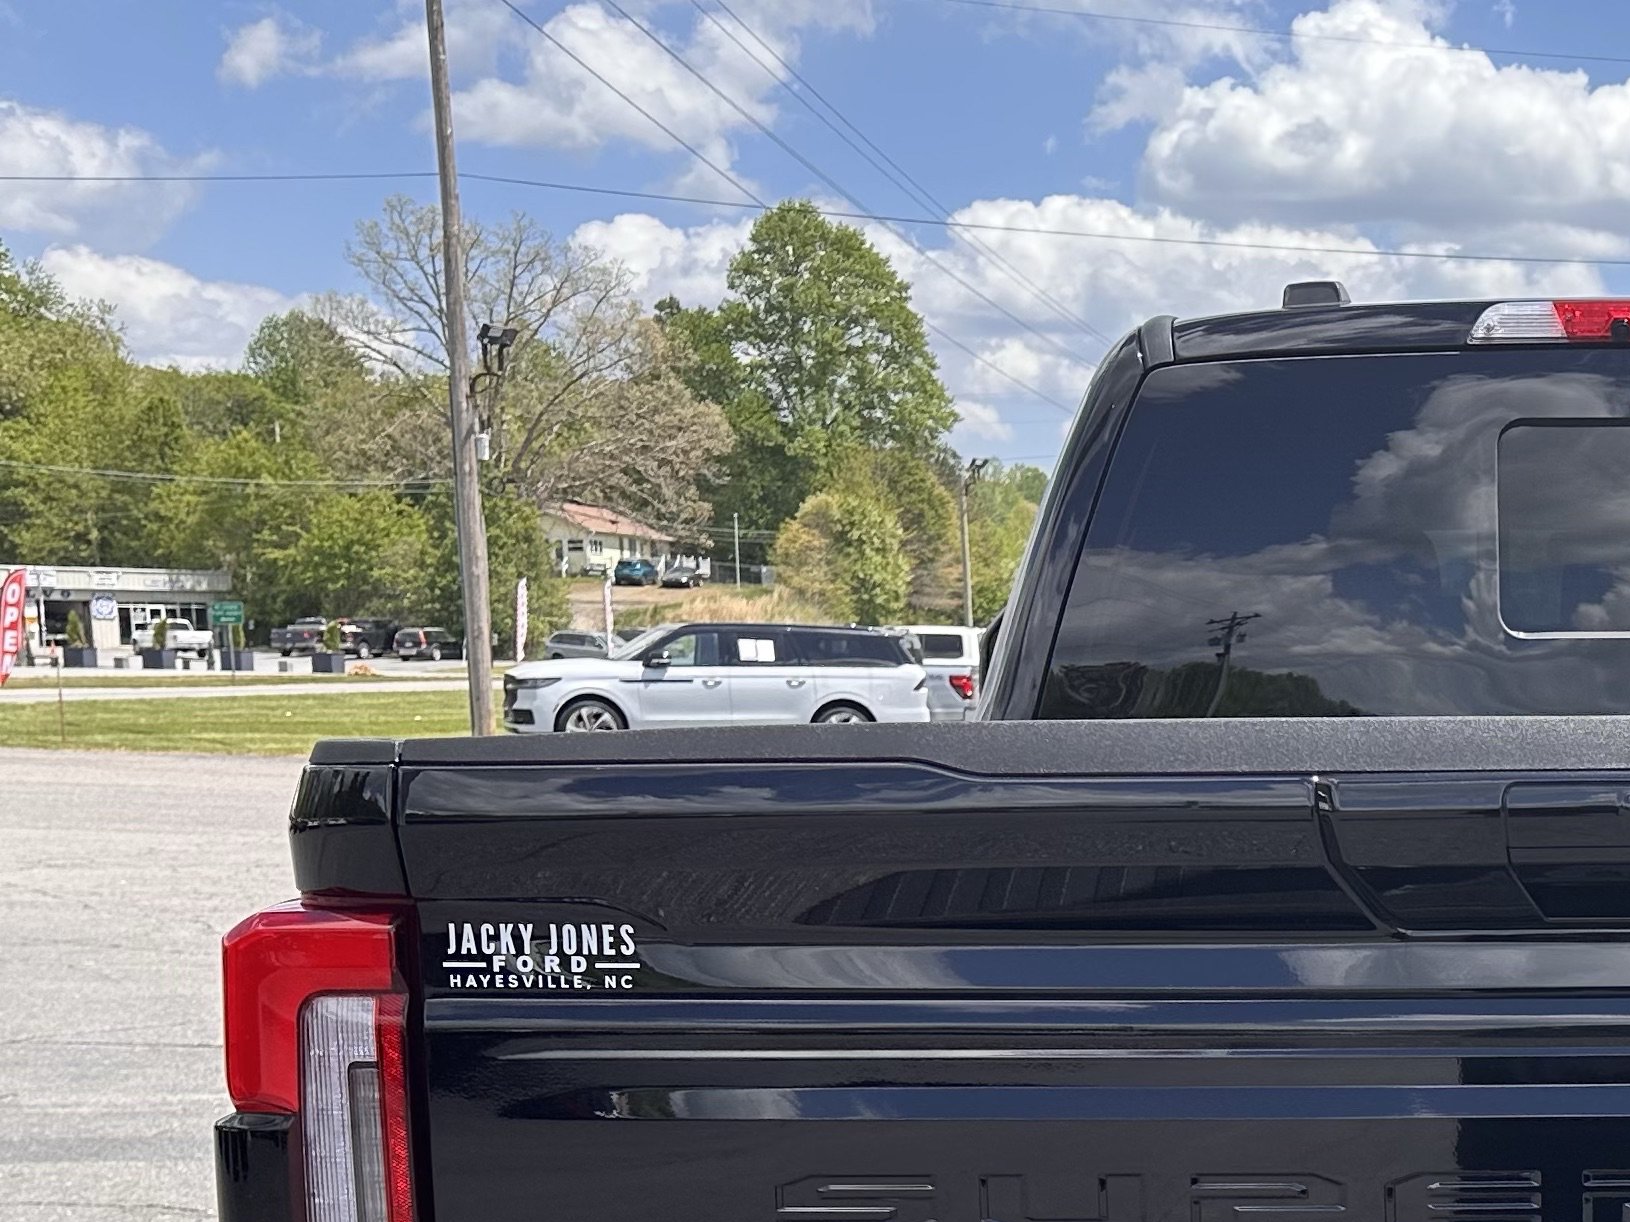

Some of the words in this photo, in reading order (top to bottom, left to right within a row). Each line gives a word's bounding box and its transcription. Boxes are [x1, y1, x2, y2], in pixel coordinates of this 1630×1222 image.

[3, 582, 20, 672] OPEN
[447, 922, 534, 955] JACKY
[549, 923, 635, 956] JONES
[492, 955, 588, 973] FORD
[449, 974, 592, 990] HAYESVILLE,
[604, 975, 634, 989] NC
